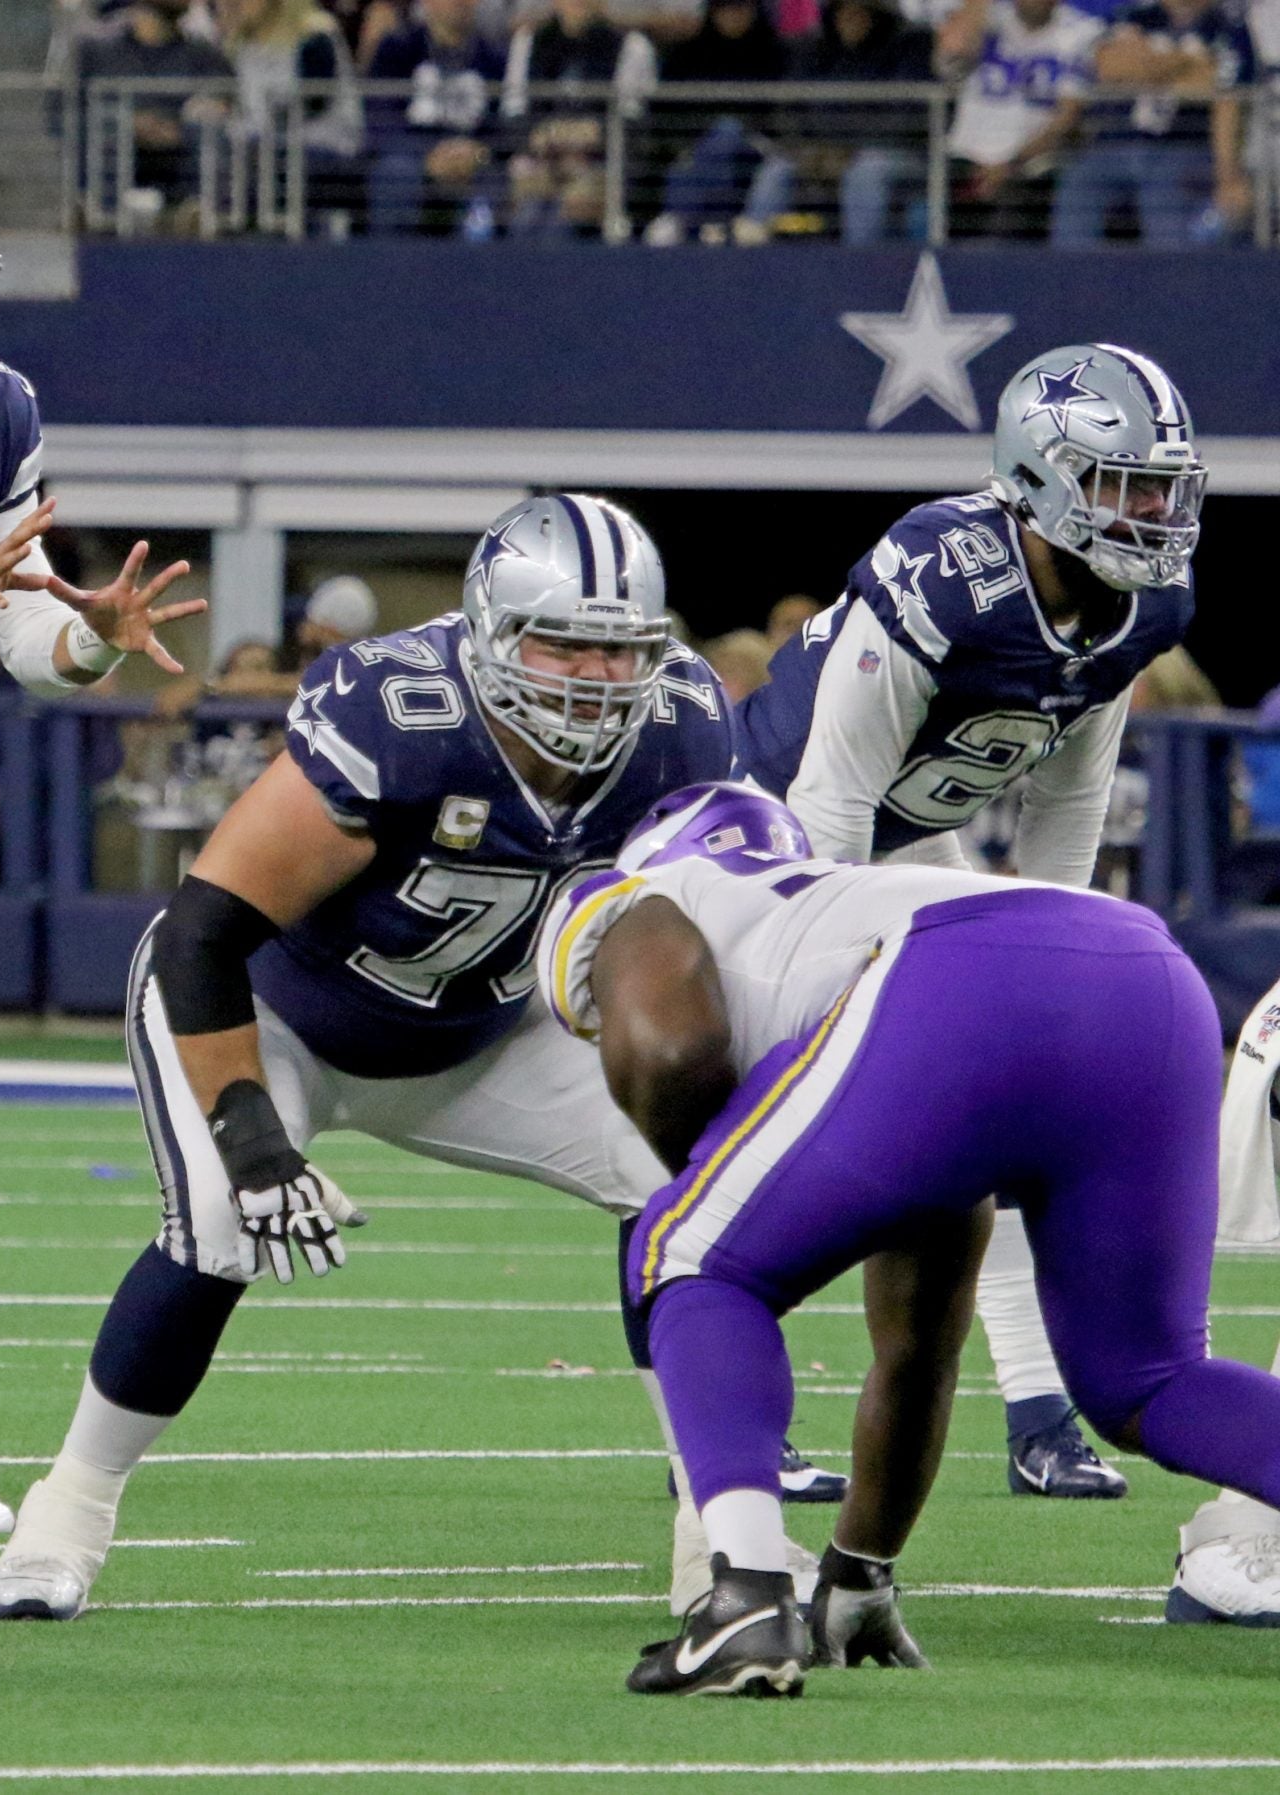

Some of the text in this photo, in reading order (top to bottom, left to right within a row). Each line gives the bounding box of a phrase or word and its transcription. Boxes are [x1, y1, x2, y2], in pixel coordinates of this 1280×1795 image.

[587, 604, 625, 614] COWBOYS
[939, 522, 1026, 614] 21
[349, 640, 466, 731] 70
[882, 702, 1106, 828] 2
[442, 801, 485, 836] C
